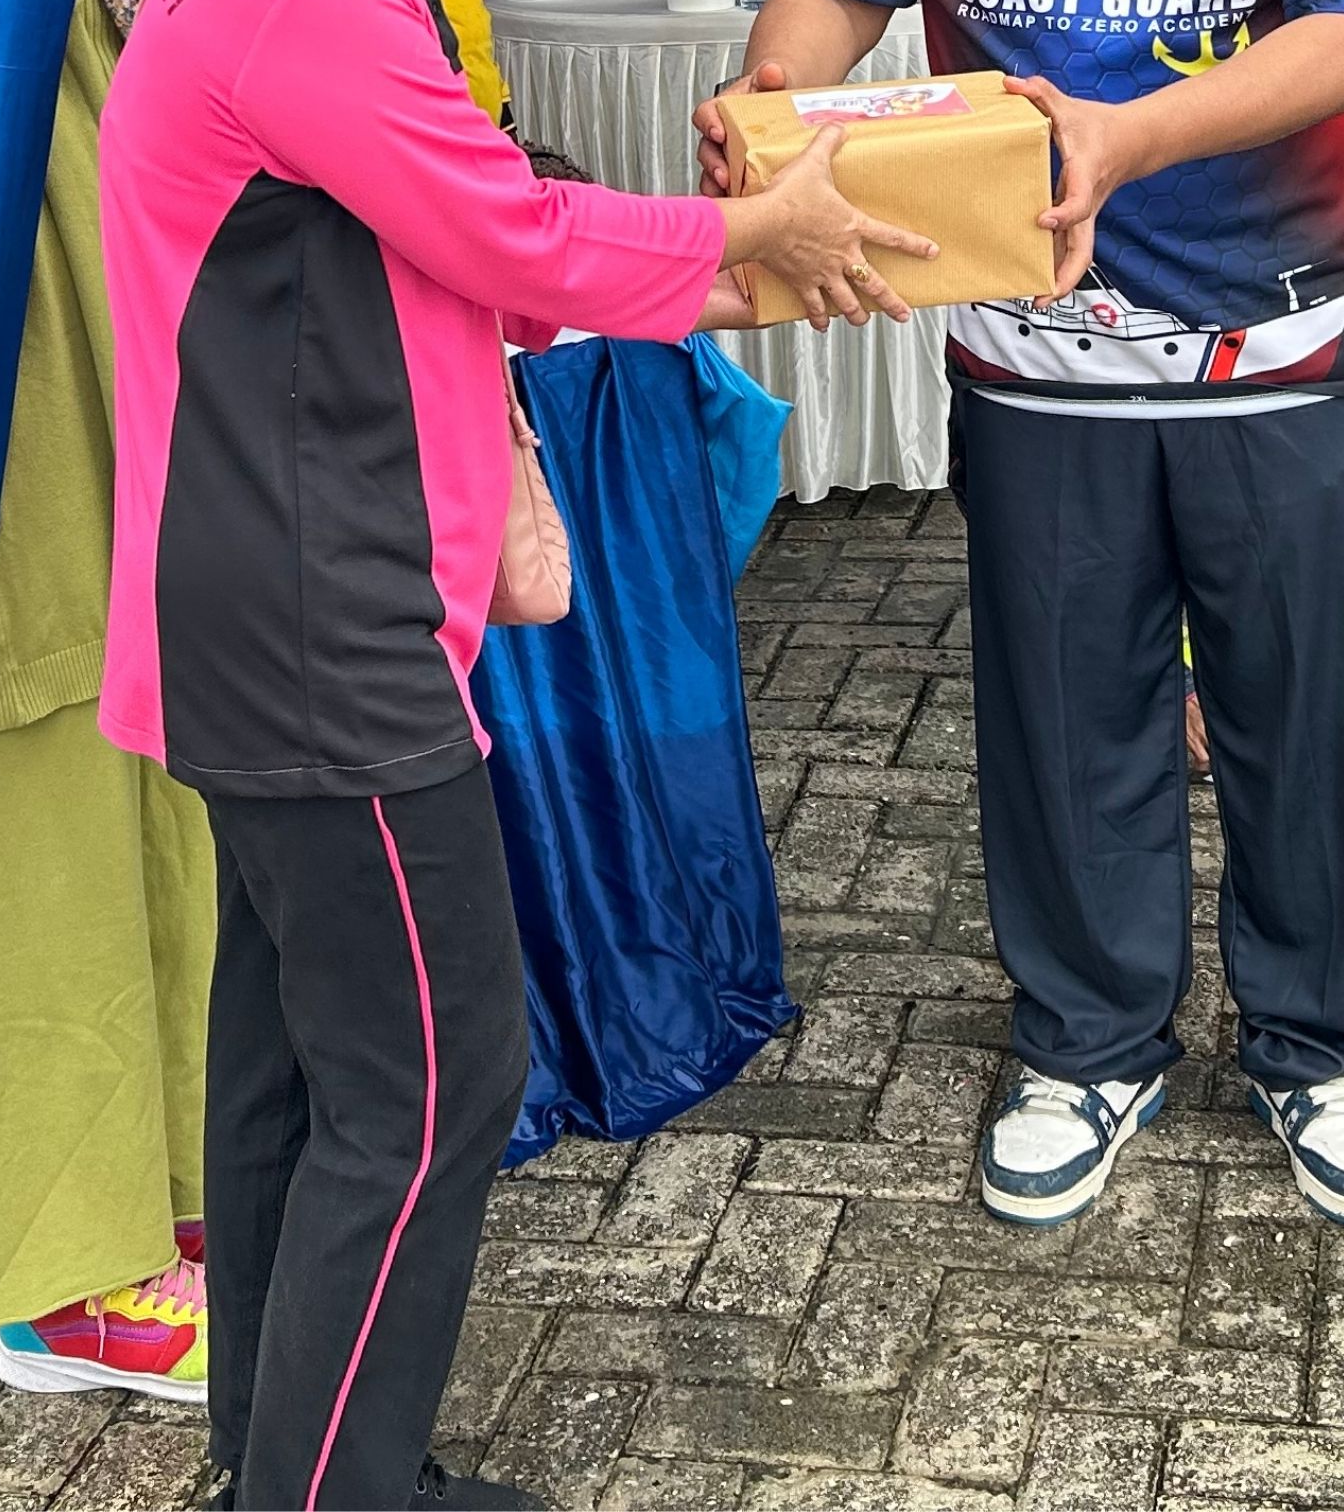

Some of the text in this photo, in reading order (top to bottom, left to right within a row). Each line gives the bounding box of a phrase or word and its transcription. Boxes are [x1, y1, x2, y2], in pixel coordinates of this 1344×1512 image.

[956, 2, 1255, 34] ROADMAP TO ZERO ACCIDENT
